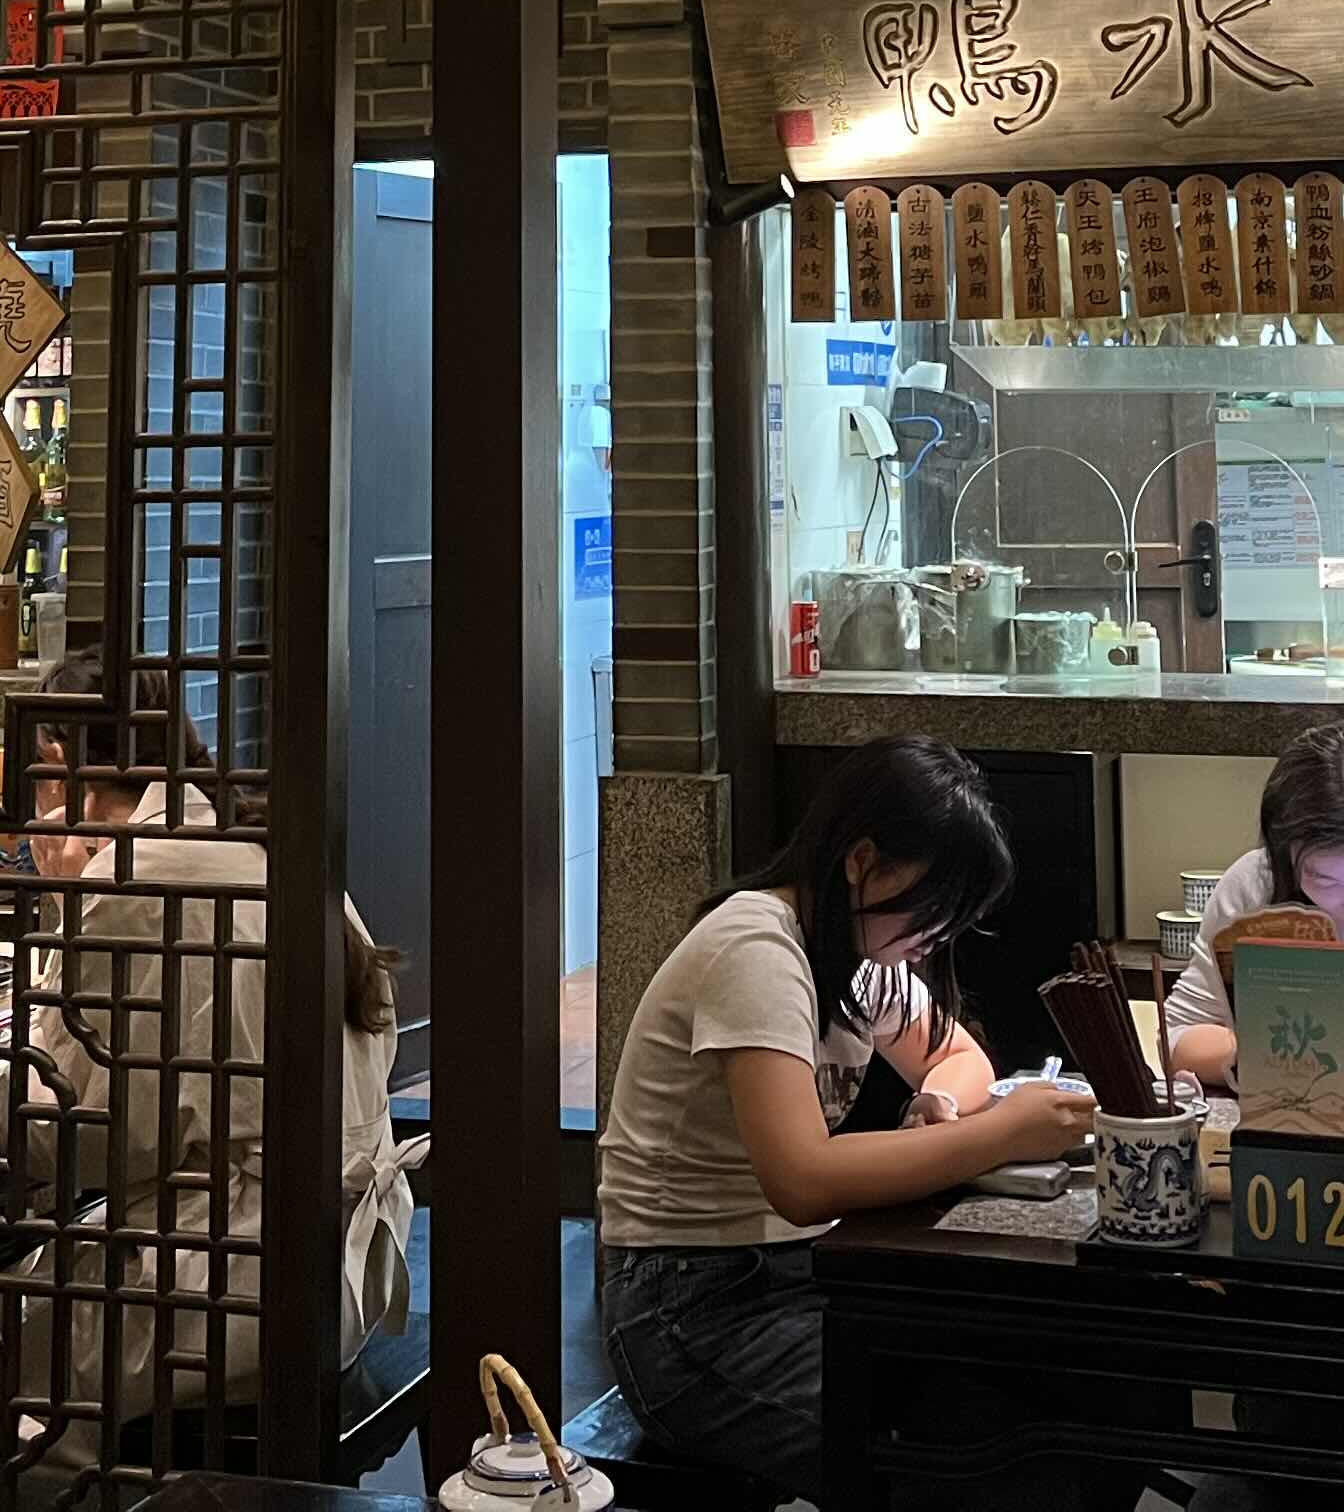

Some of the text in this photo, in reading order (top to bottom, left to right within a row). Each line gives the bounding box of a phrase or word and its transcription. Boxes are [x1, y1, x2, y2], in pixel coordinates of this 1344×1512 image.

[907, 195, 934, 310] 古法糖芋苗
[1075, 189, 1111, 306] 天王烤鴨包
[1249, 190, 1278, 299] 南京素什錦
